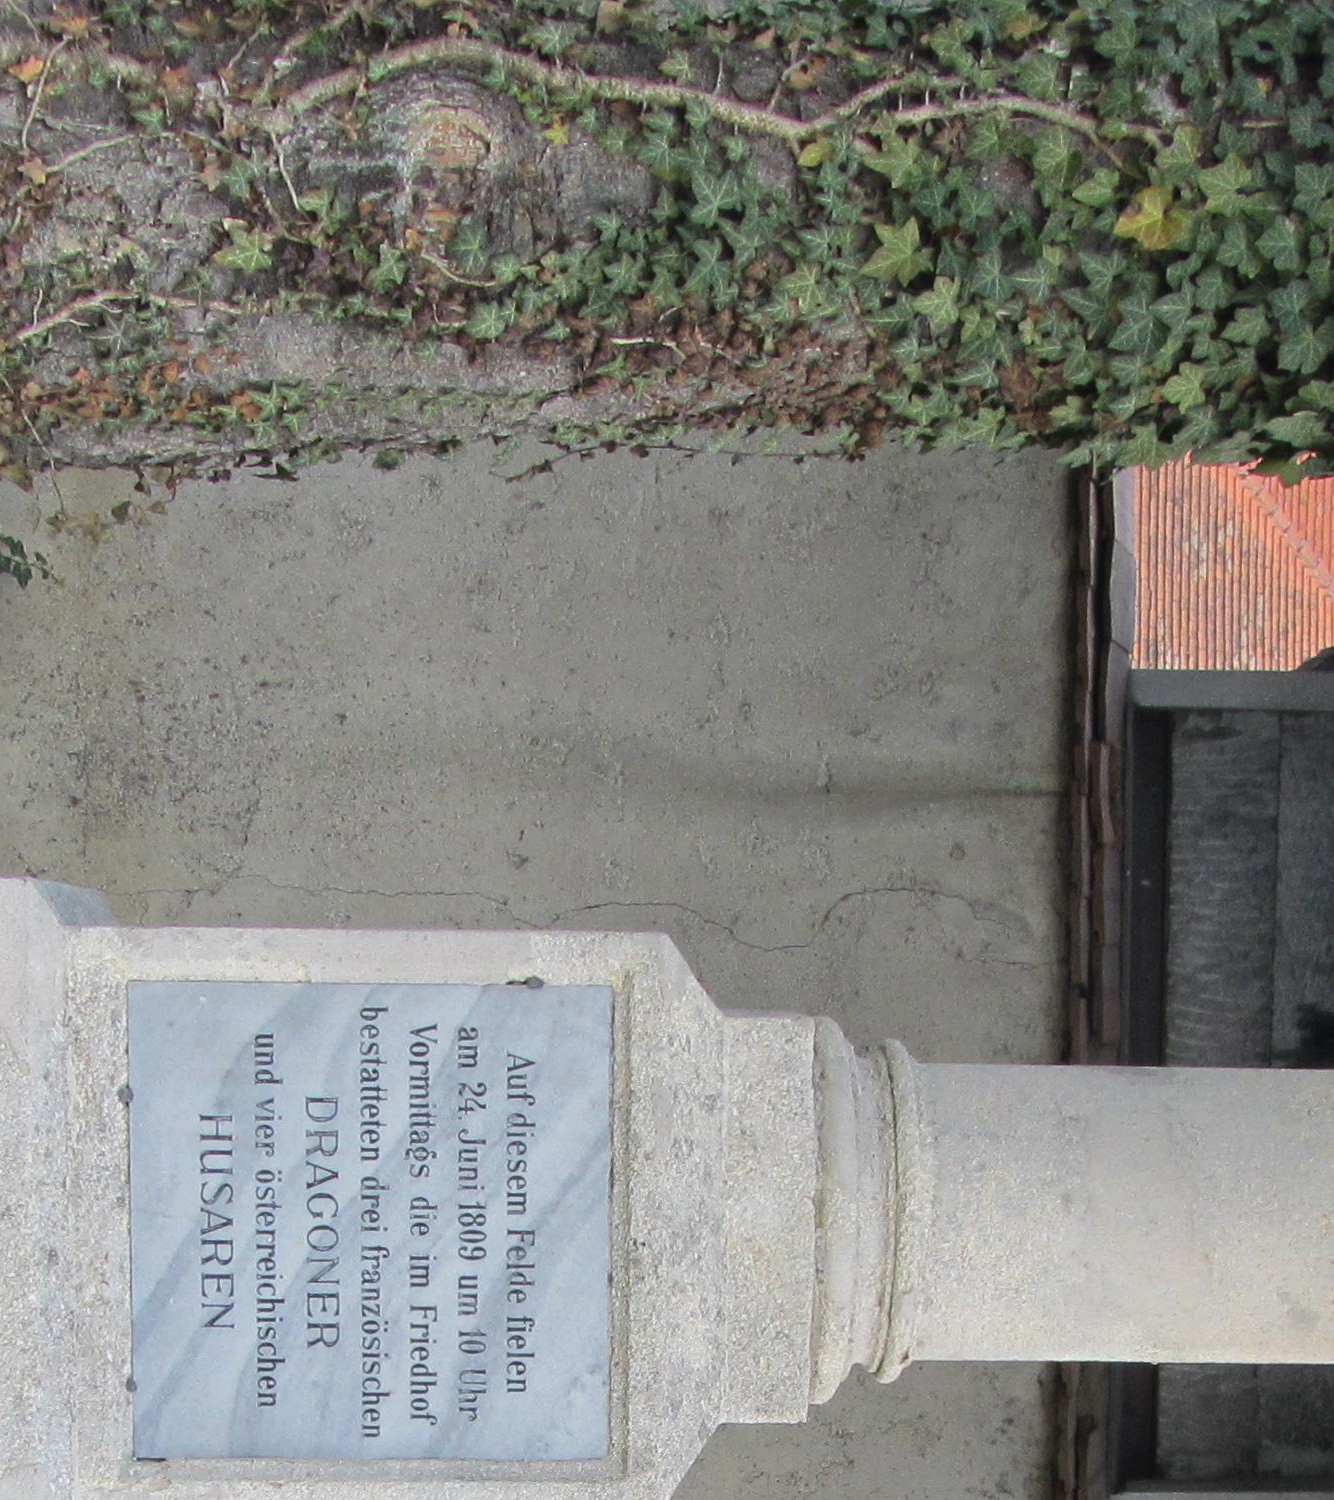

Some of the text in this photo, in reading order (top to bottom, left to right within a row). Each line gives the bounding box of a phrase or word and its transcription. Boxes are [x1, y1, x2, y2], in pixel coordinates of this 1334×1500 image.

[198, 1113, 236, 1329] HUSAREN
[253, 1032, 287, 1408] und vier österreichischen
[305, 1095, 341, 1349] DRAGONER
[359, 1005, 392, 1438] bestatteten drei französischen
[403, 1023, 439, 1427] Vormittags die im Friedhof
[456, 1025, 488, 1422] am 24. Juni 1809 um 10 Uhr
[505, 1051, 537, 1394] Auf diesem Felde fielen
